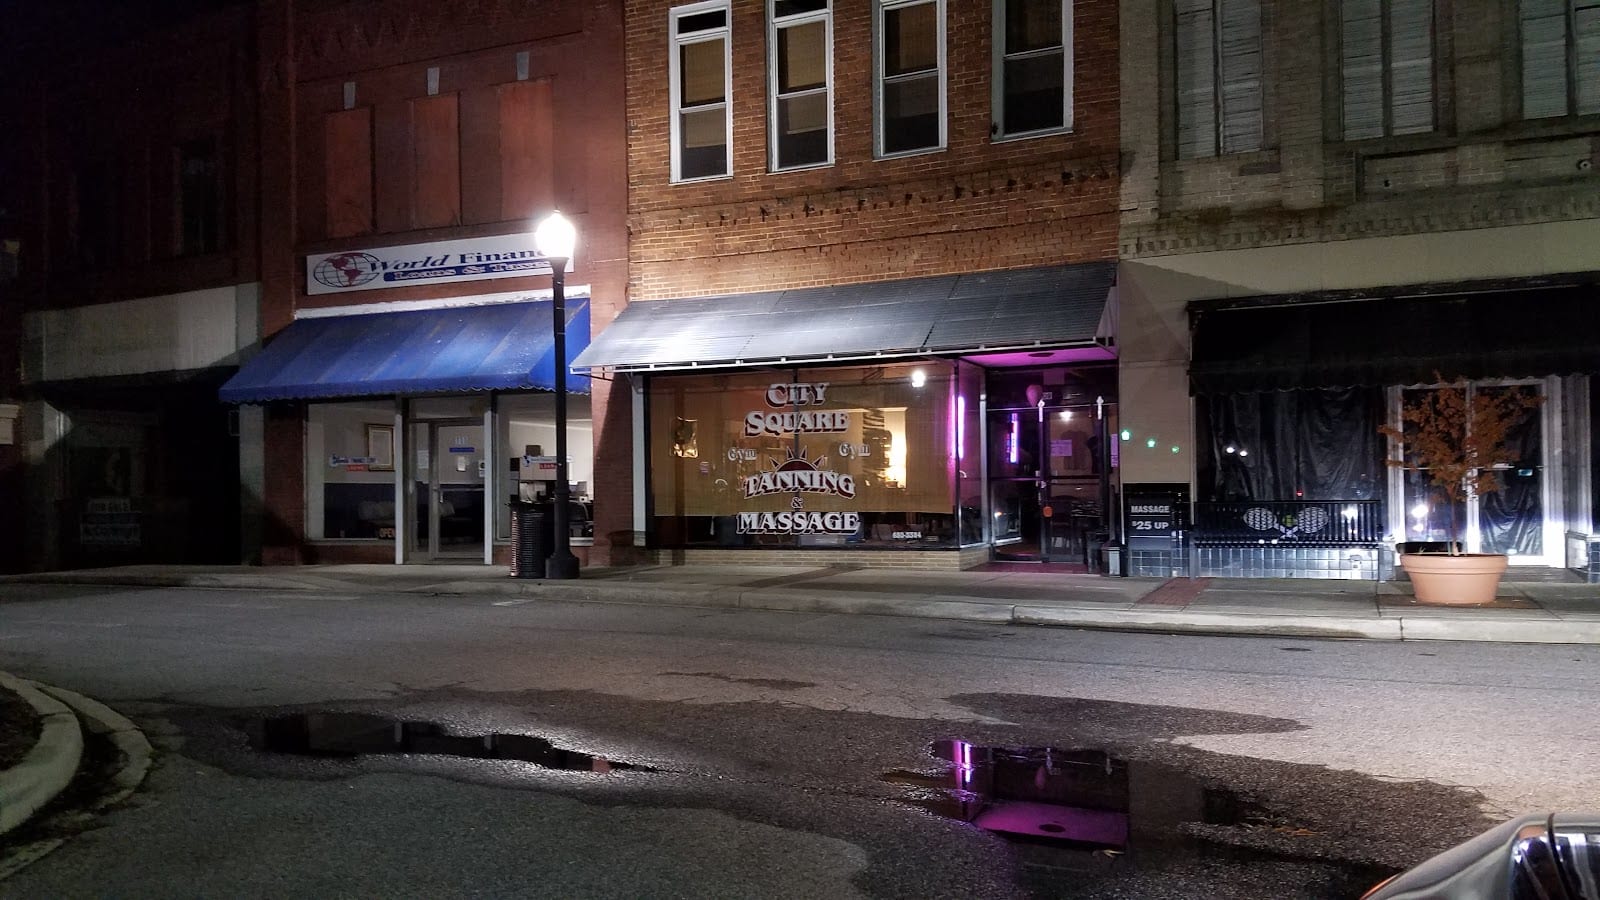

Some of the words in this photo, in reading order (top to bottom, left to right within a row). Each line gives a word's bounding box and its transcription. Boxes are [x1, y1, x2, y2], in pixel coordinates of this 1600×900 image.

[370, 254, 450, 272] World
[459, 250, 547, 264] Financ
[393, 269, 456, 280] Loans
[462, 266, 485, 275] &
[765, 382, 830, 408] CITY
[744, 410, 849, 438] SQUARE
[728, 447, 757, 463] Gym
[839, 442, 870, 459] Gym
[743, 470, 856, 499] TANNING
[791, 497, 803, 509] &
[1131, 505, 1170, 513] MASSAGE
[736, 512, 860, 535] MASSAGE
[1132, 521, 1152, 530] $25
